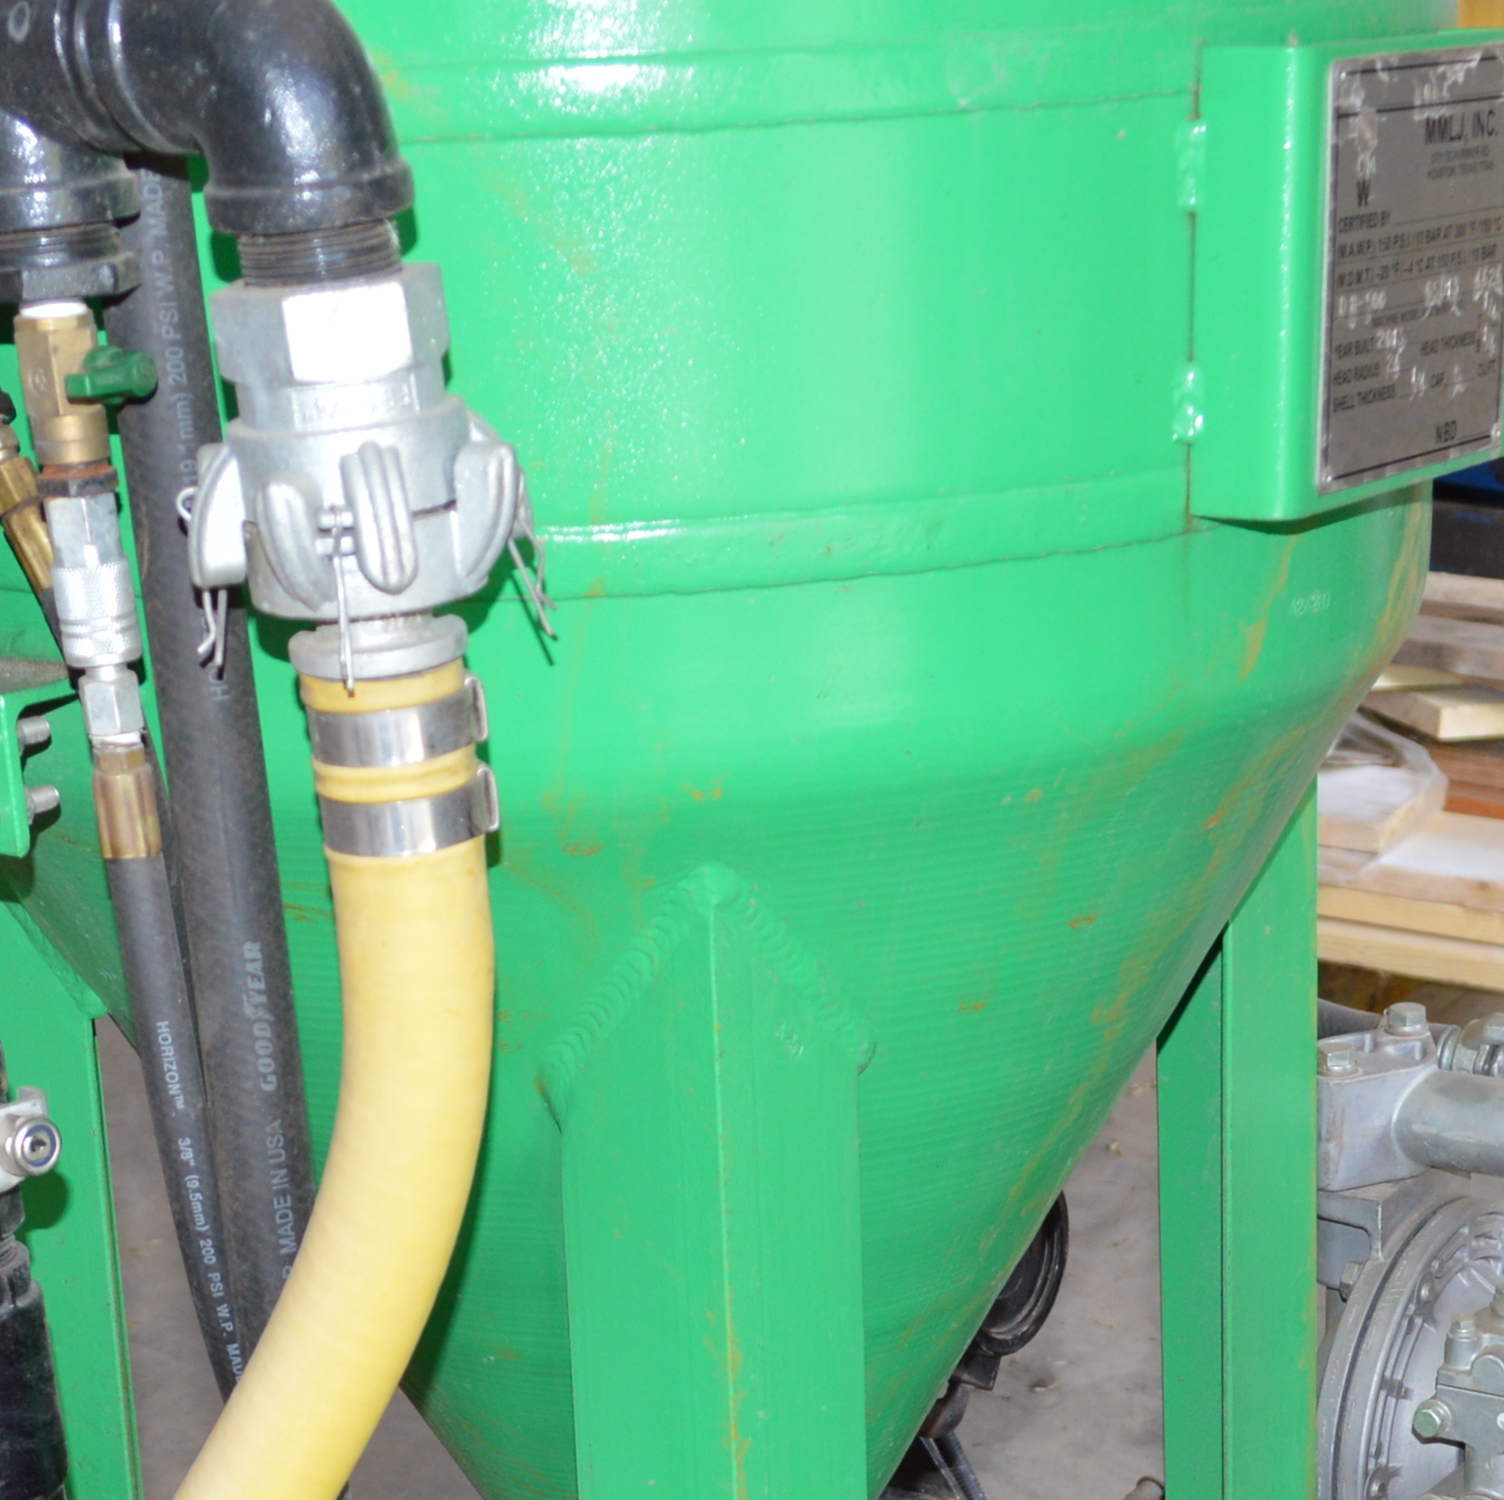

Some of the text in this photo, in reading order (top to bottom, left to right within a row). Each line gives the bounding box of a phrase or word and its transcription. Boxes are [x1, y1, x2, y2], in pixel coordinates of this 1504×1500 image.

[1472, 109, 1499, 139] INC.
[1338, 210, 1391, 232] CERTIFIED BY
[1425, 227, 1441, 242] BAR
[160, 301, 183, 340] PSI
[1334, 343, 1352, 359] YEAR
[1354, 337, 1374, 354] BUILT
[166, 347, 188, 386] 200
[1332, 368, 1352, 385] HEAD
[1332, 394, 1355, 412] SHELL
[1357, 383, 1395, 406] THICKNESS
[243, 940, 277, 1092] GOODYEAR
[266, 1118, 286, 1166] USA
[271, 1169, 289, 1194] IN
[184, 1174, 210, 1232] (9.5mm)
[273, 1194, 297, 1256] MADE
[199, 1238, 217, 1265] 200
[208, 1272, 225, 1298] PSI
[216, 1302, 234, 1338] W.P.
